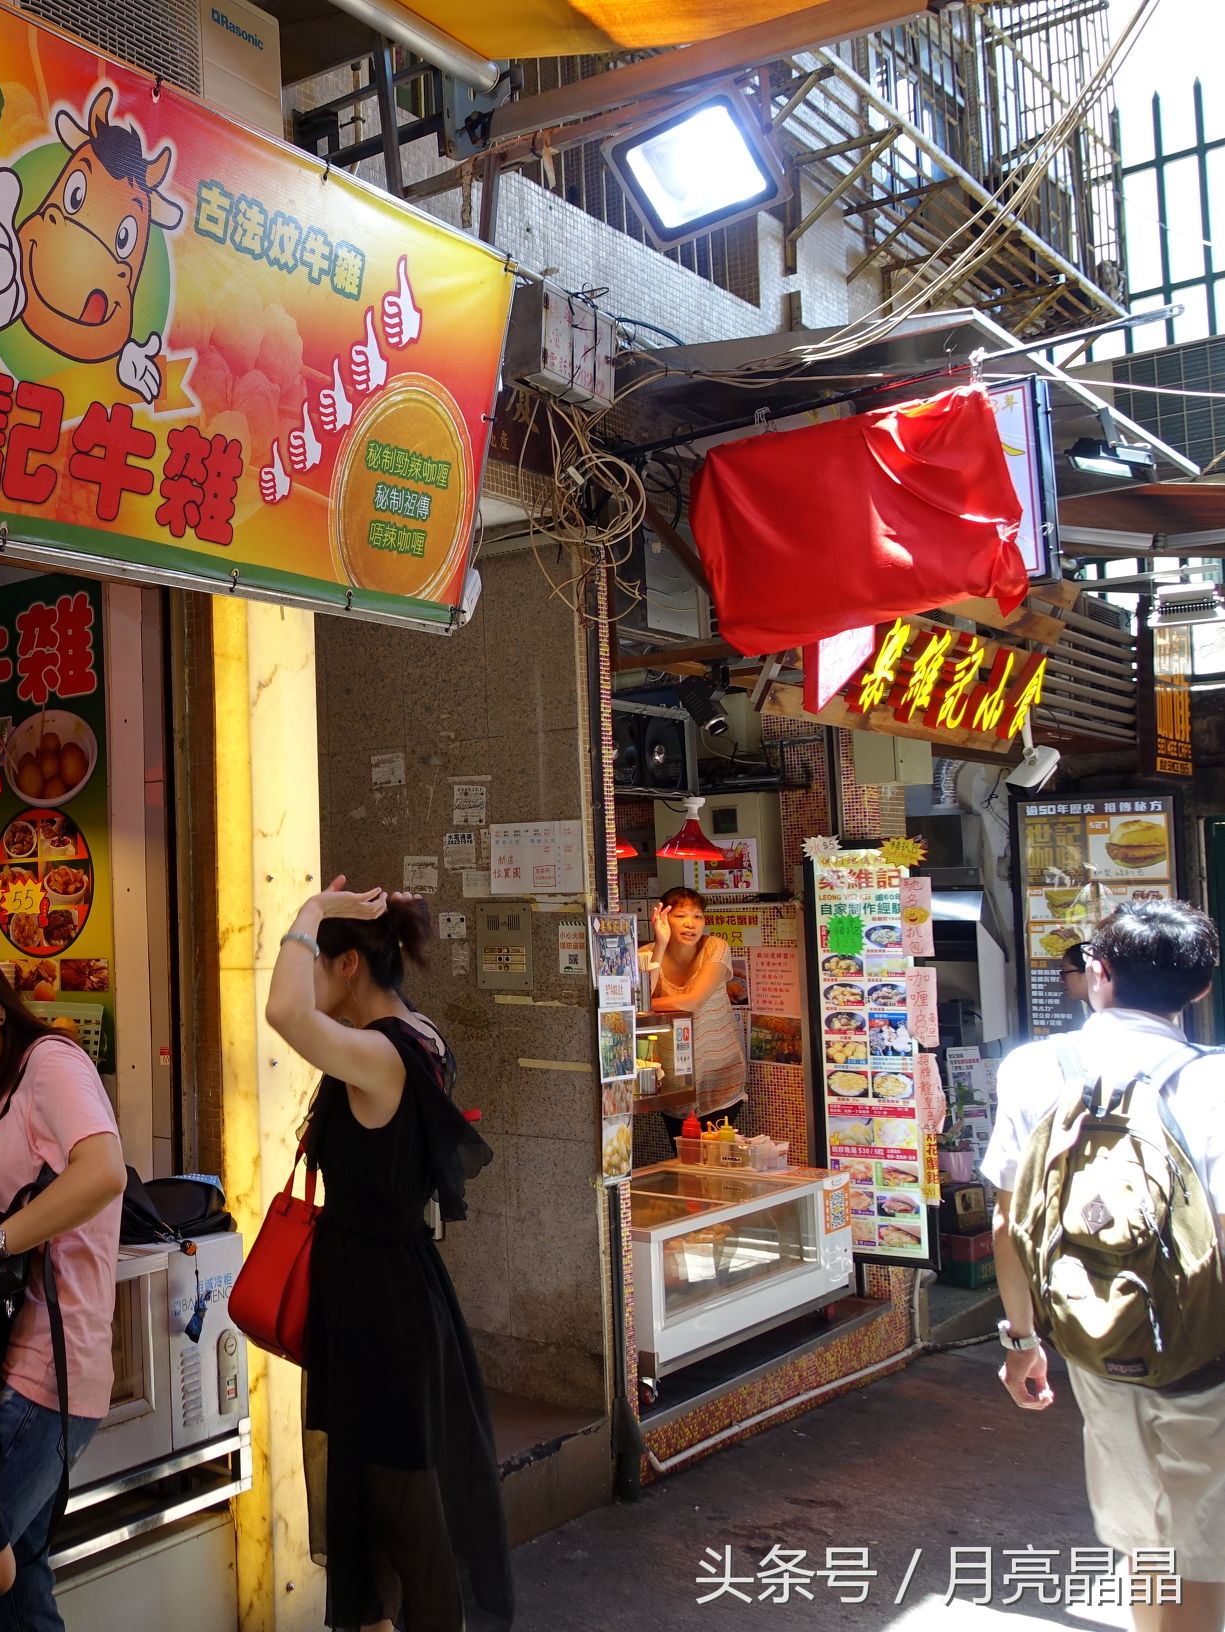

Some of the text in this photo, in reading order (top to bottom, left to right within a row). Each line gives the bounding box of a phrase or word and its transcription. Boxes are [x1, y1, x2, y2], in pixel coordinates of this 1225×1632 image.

[220, 12, 264, 50] Rasonic
[194, 179, 366, 300] 古法炆牛雜
[366, 440, 451, 489] 秘制勁辣咖喱
[374, 485, 431, 521] 秘制祖傳
[368, 522, 427, 557] 唔辣咖喱
[1103, 800, 1163, 813] 祖傳秘方
[12, 889, 34, 911] 55
